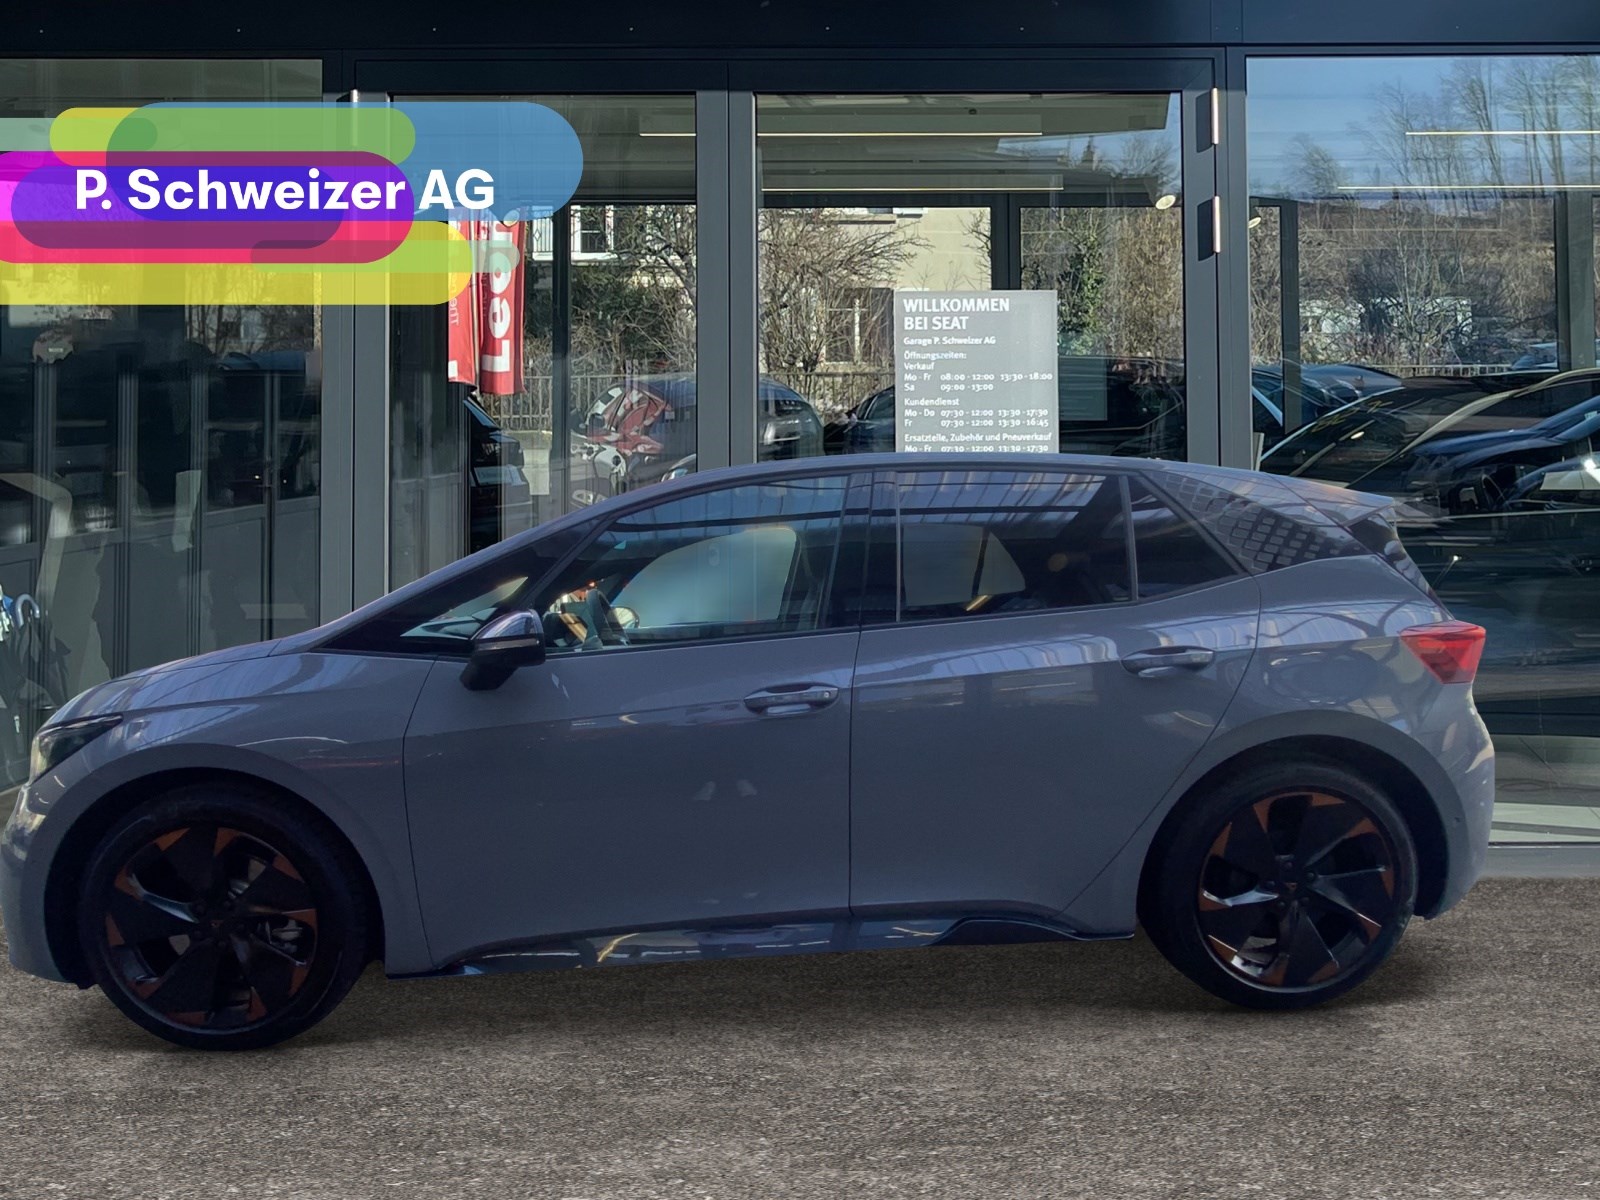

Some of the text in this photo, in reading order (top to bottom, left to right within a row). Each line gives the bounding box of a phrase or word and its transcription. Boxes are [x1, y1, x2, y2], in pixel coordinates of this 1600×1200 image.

[903, 298, 1010, 312] WILLKOMMEN
[904, 316, 969, 330] BEI SEAT
[903, 336, 996, 347] Garage P. Schweizer AG
[904, 350, 967, 361] Öffnungszeiten:
[904, 362, 935, 371] Verkauf
[904, 373, 917, 381] Mo
[923, 373, 931, 381] Fr
[940, 373, 965, 381] 08:00
[1029, 372, 1053, 380] 18:00
[904, 384, 915, 392] Sa
[940, 384, 965, 392] 09:00
[971, 384, 994, 392] 13:00
[904, 398, 959, 407] Kundendienst
[904, 409, 917, 417] Mo
[923, 409, 936, 417] Do
[940, 409, 964, 418] 07:30
[998, 410, 1021, 418] 13:30
[1026, 409, 1049, 417] 17:30
[904, 419, 913, 427] Fr
[940, 420, 964, 428] 07:30
[998, 419, 1021, 427] 13:30
[904, 432, 1053, 442] Ersatzteile, Zubehör und Pneuverkauf
